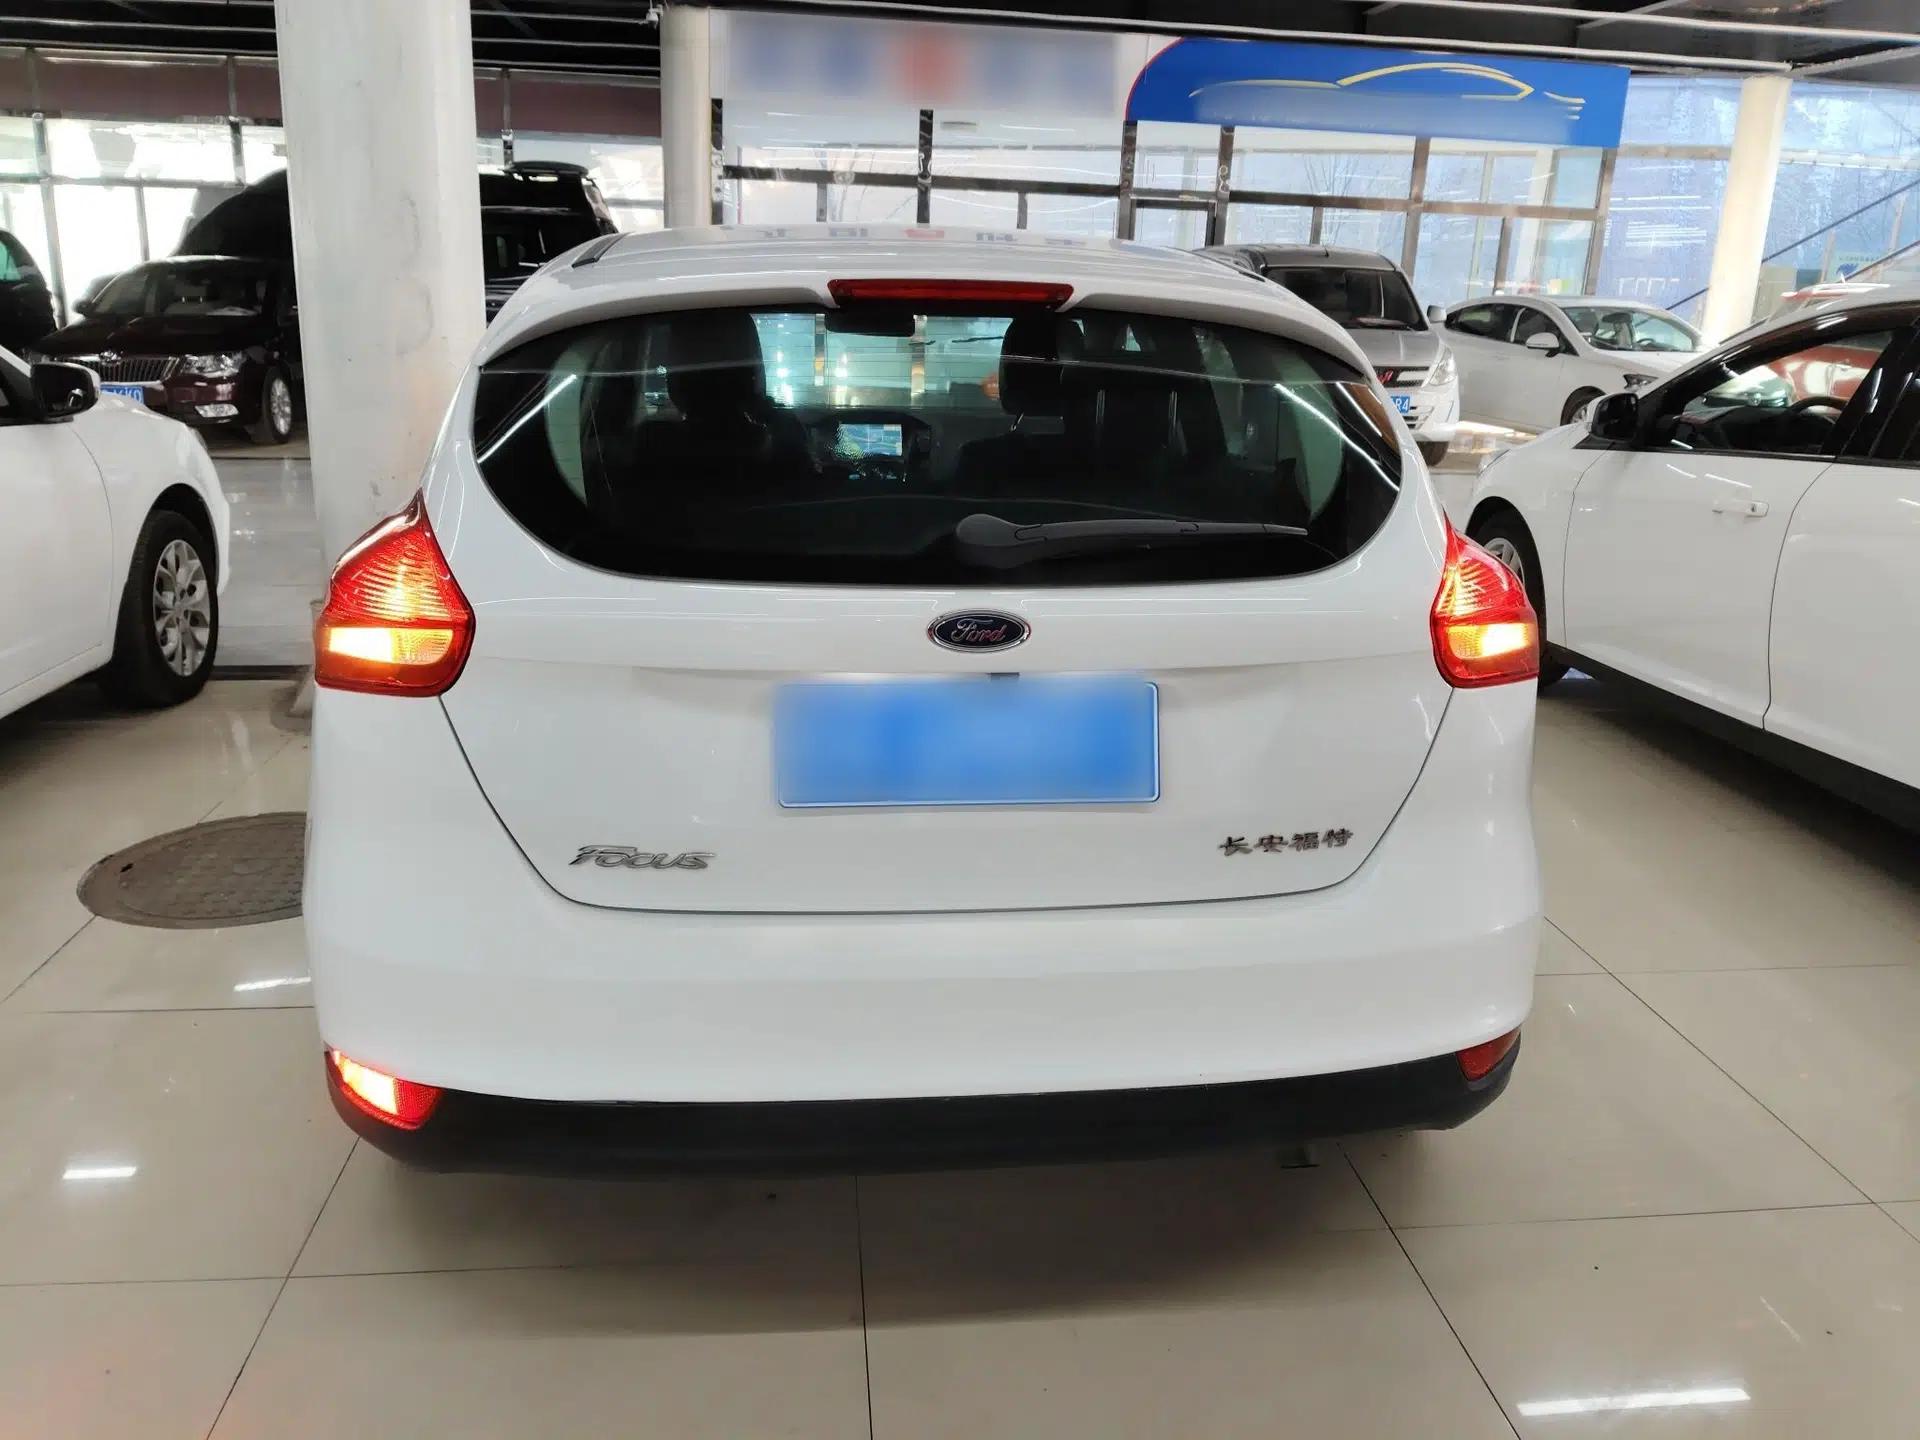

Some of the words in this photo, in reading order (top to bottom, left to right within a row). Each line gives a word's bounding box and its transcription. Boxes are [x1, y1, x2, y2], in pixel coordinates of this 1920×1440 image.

[951, 618, 1008, 642] Ford
[1218, 827, 1354, 857] 长安福特
